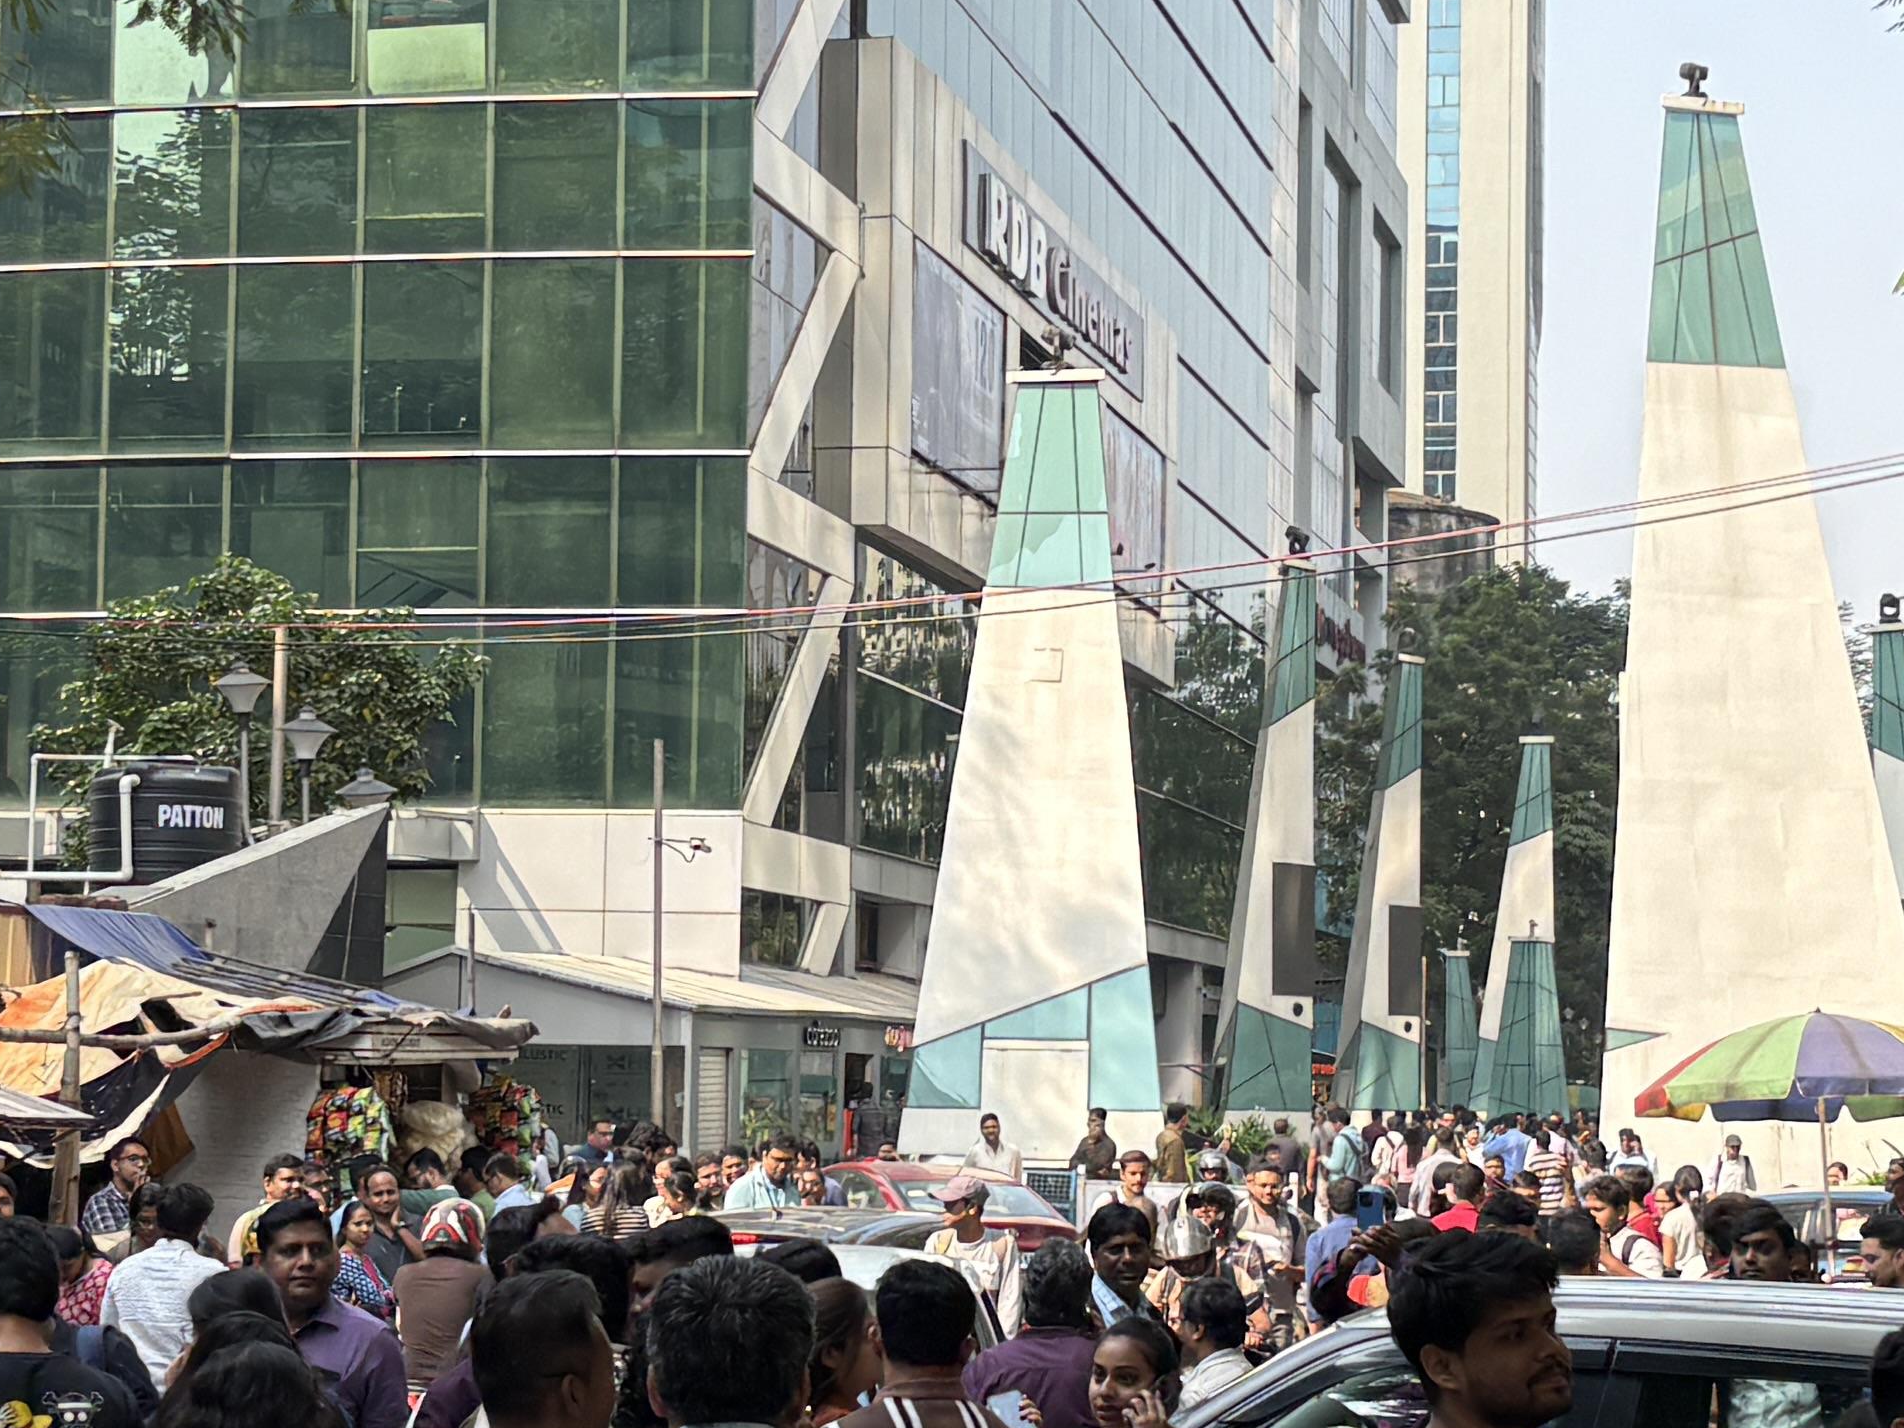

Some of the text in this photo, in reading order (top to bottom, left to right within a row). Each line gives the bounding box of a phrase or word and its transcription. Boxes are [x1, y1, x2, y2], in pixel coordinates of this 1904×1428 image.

[978, 172, 1047, 299] RDB
[1046, 246, 1131, 374] Cinemas
[158, 804, 224, 829] PATTON
